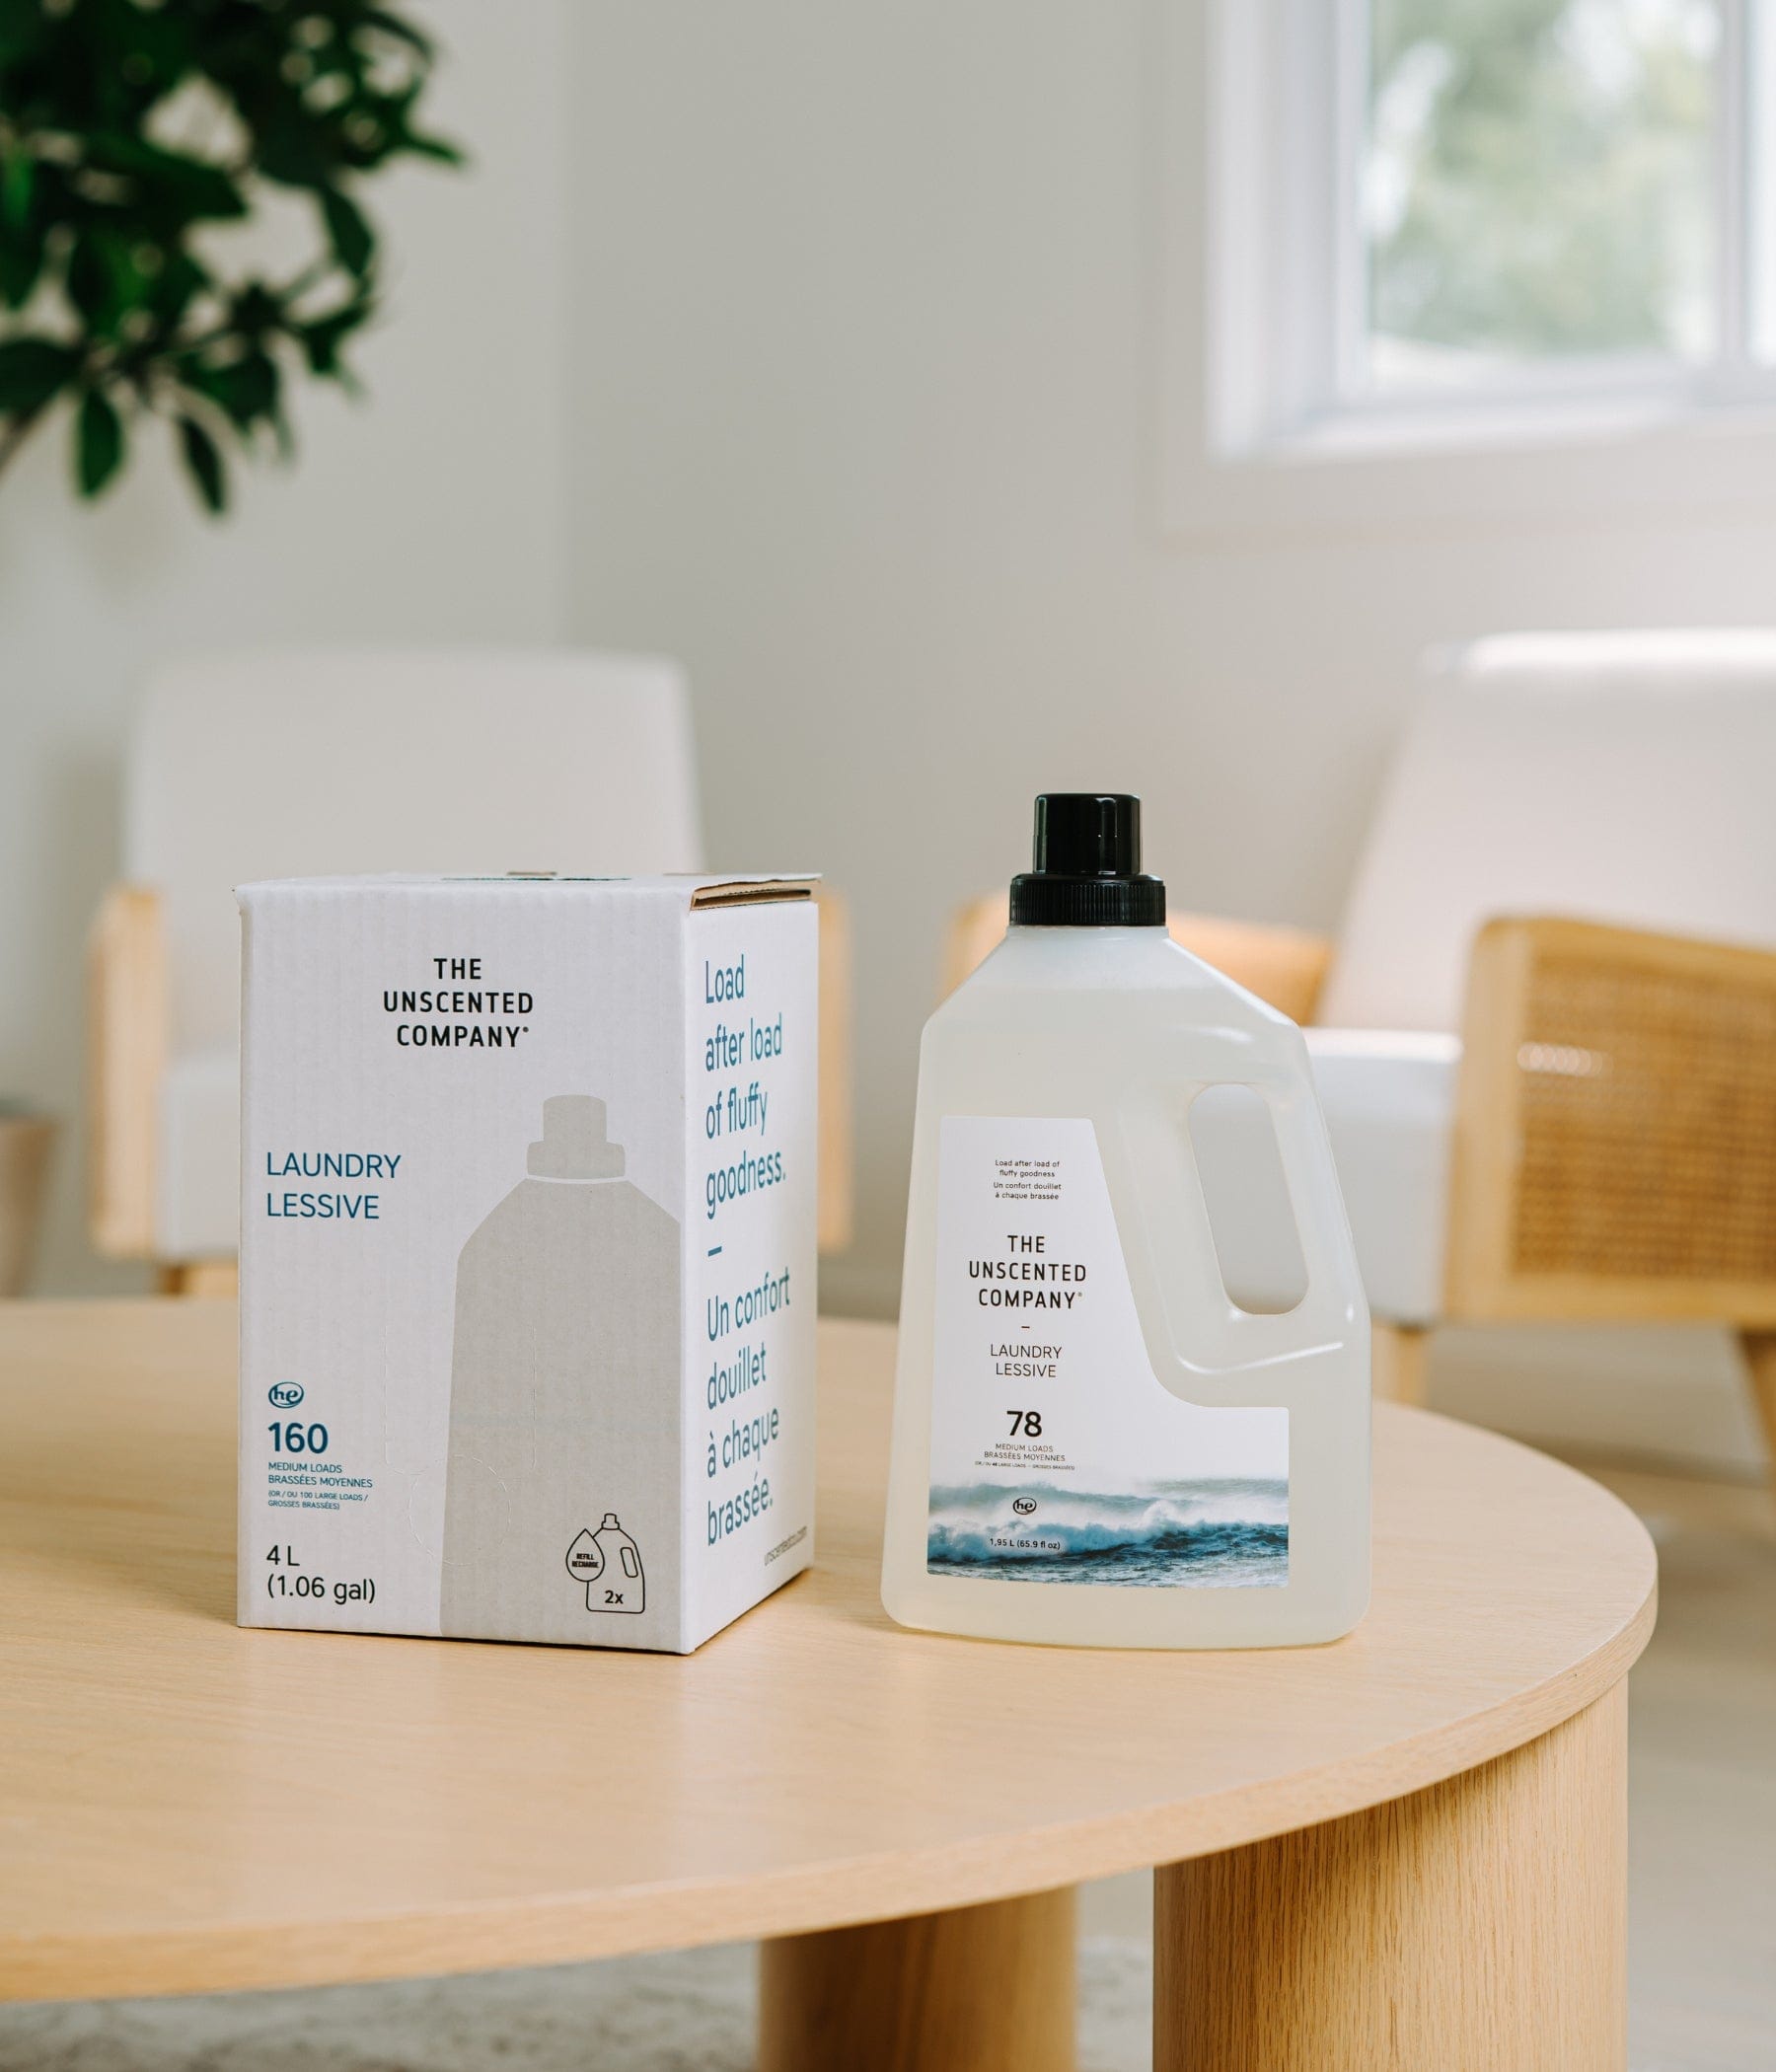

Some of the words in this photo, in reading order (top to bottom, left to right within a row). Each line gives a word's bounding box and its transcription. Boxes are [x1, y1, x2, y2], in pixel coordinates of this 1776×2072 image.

[433, 958, 481, 980] THE
[705, 953, 745, 1004] Load
[383, 991, 533, 1014] UNSCENTED
[705, 1023, 745, 1072] after
[750, 1011, 782, 1062] load
[705, 1090, 722, 1140] of
[727, 1081, 768, 1136] fluffy
[266, 1151, 402, 1178] LAUNDRY
[999, 1169, 1018, 1178] fluffy
[706, 1149, 786, 1221] goodness.
[266, 1192, 380, 1220] LESSIVE
[1001, 1192, 1028, 1201] chaque
[1006, 1234, 1045, 1253] THE
[969, 1260, 1086, 1282] UNSCENTED
[707, 1295, 729, 1342] Un
[735, 1266, 790, 1329] confort
[990, 1344, 1063, 1359] LAUNDRY
[707, 1341, 767, 1410] douillet
[996, 1363, 1057, 1377] LESSIVE
[1006, 1410, 1043, 1438] 78
[267, 1422, 329, 1454] 160
[707, 1431, 716, 1478] à
[722, 1408, 779, 1469] chaque
[995, 1443, 1026, 1451] MEDIUM
[984, 1450, 1021, 1460] BRASSÉES
[1023, 1452, 1066, 1461] MOYENNES
[267, 1461, 308, 1472] MEDIUM
[310, 1463, 342, 1473] LOADS
[267, 1474, 317, 1485] BRASSÉES
[320, 1477, 373, 1488] MOYENNES
[267, 1499, 300, 1508] GROSSES
[707, 1471, 774, 1546] brassée.
[266, 1545, 281, 1565] 4
[287, 1545, 300, 1566] L
[1016, 1539, 1038, 1548] (65.9
[1047, 1541, 1061, 1550] oz)
[267, 1573, 325, 1598] (1.06
[333, 1579, 375, 1605] gal)
[604, 1590, 624, 1604] 2x
